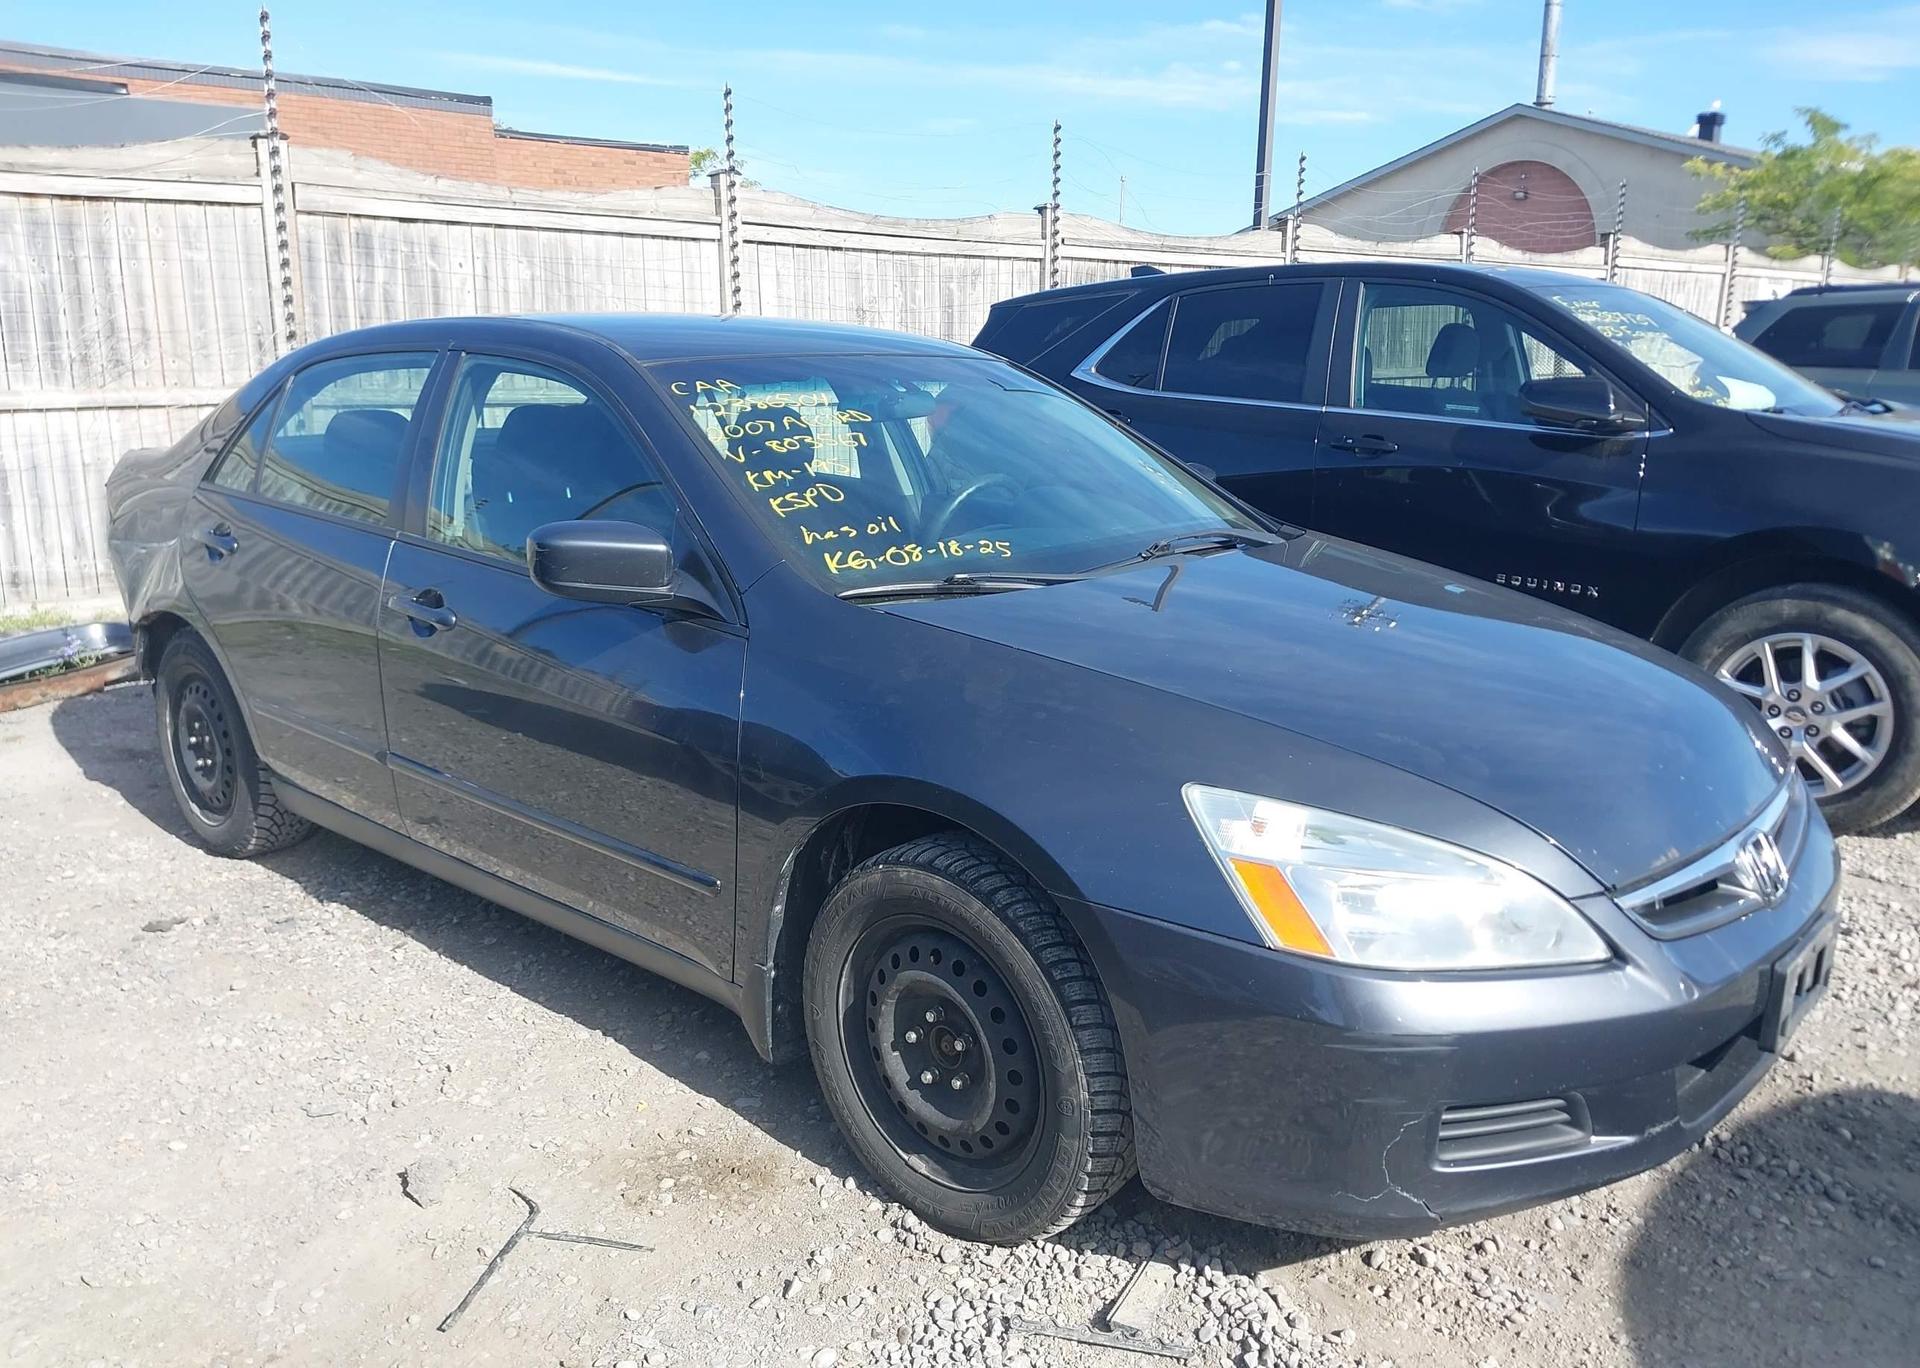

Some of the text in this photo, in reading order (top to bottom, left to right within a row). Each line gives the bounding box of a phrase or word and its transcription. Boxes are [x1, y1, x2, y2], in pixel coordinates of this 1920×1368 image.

[671, 379, 741, 396] CAA
[800, 516, 902, 545] has oil
[1496, 573, 1599, 598] EQUINOX
